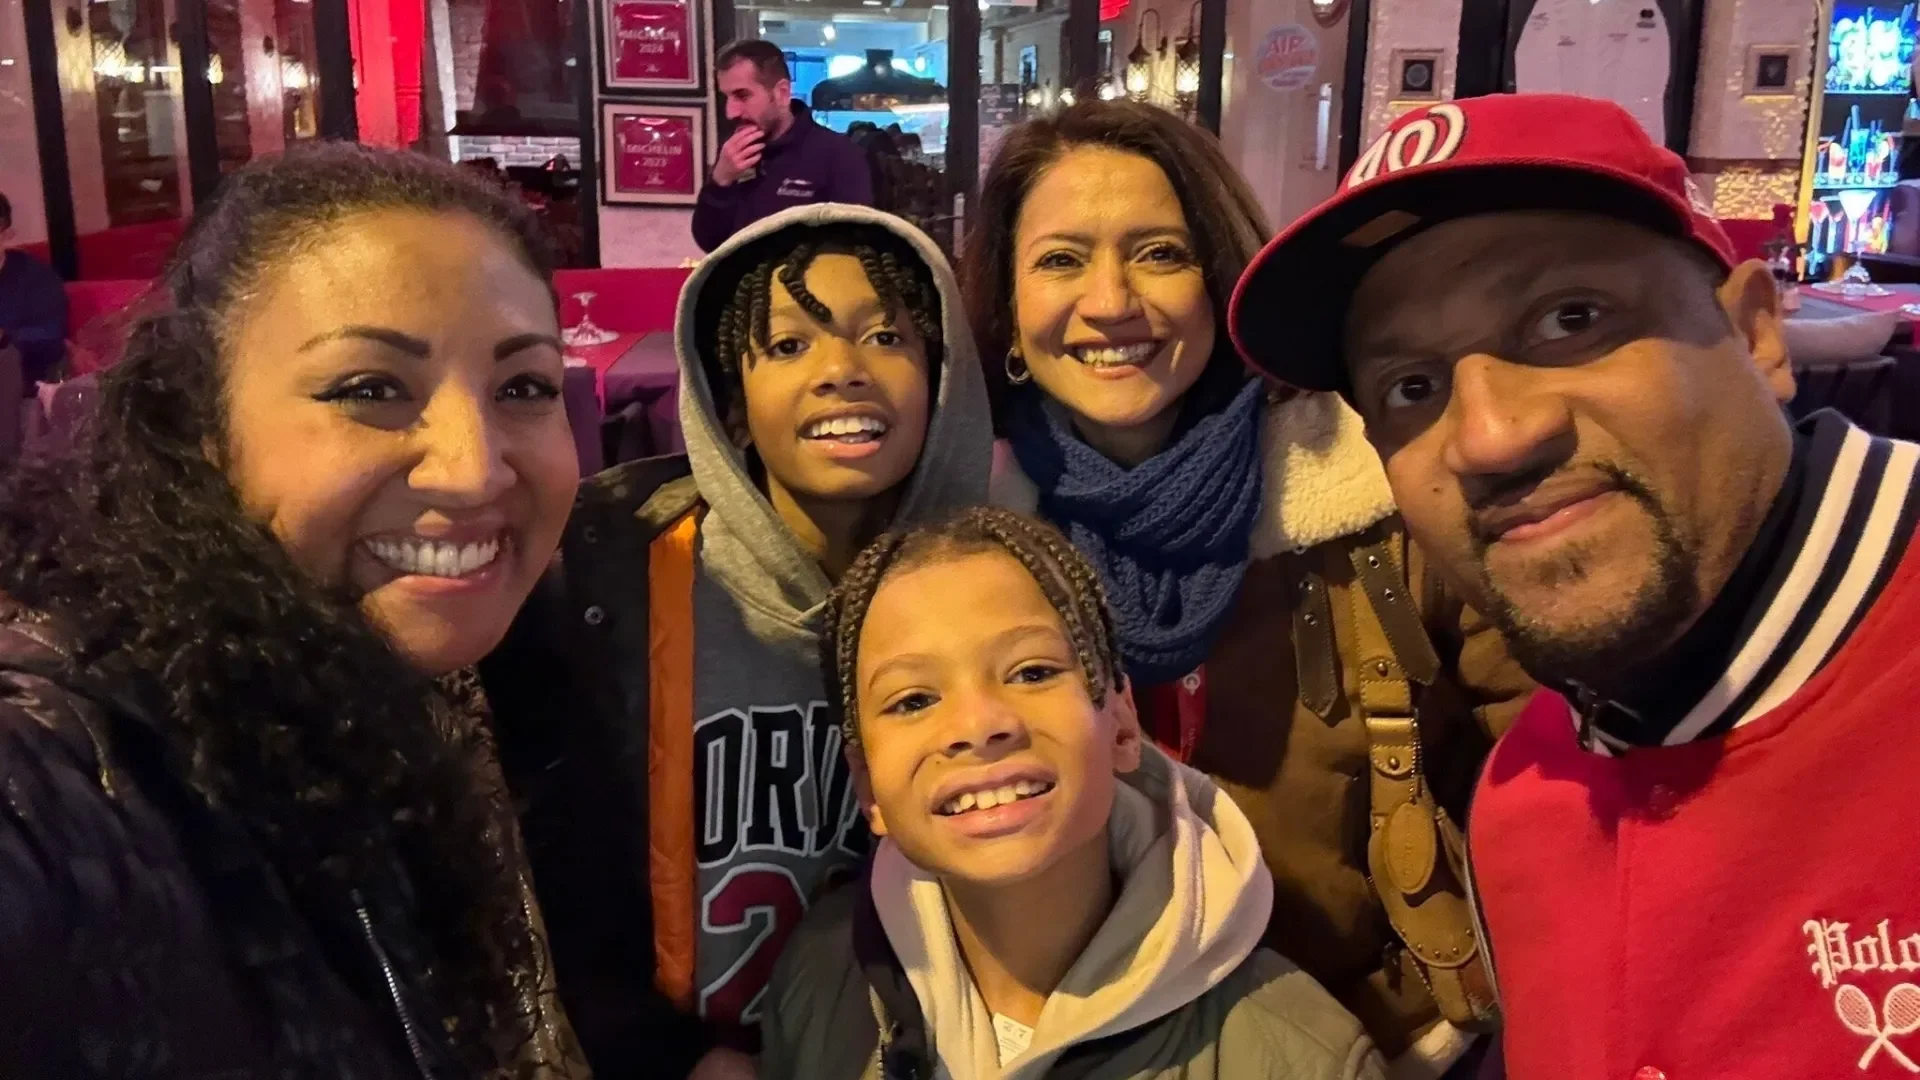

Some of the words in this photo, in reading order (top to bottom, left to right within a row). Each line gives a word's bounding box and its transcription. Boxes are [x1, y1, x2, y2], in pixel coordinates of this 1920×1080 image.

[639, 43, 665, 53] 2024
[626, 144, 682, 155] MICHELIN
[1803, 918, 1920, 989] Polo
